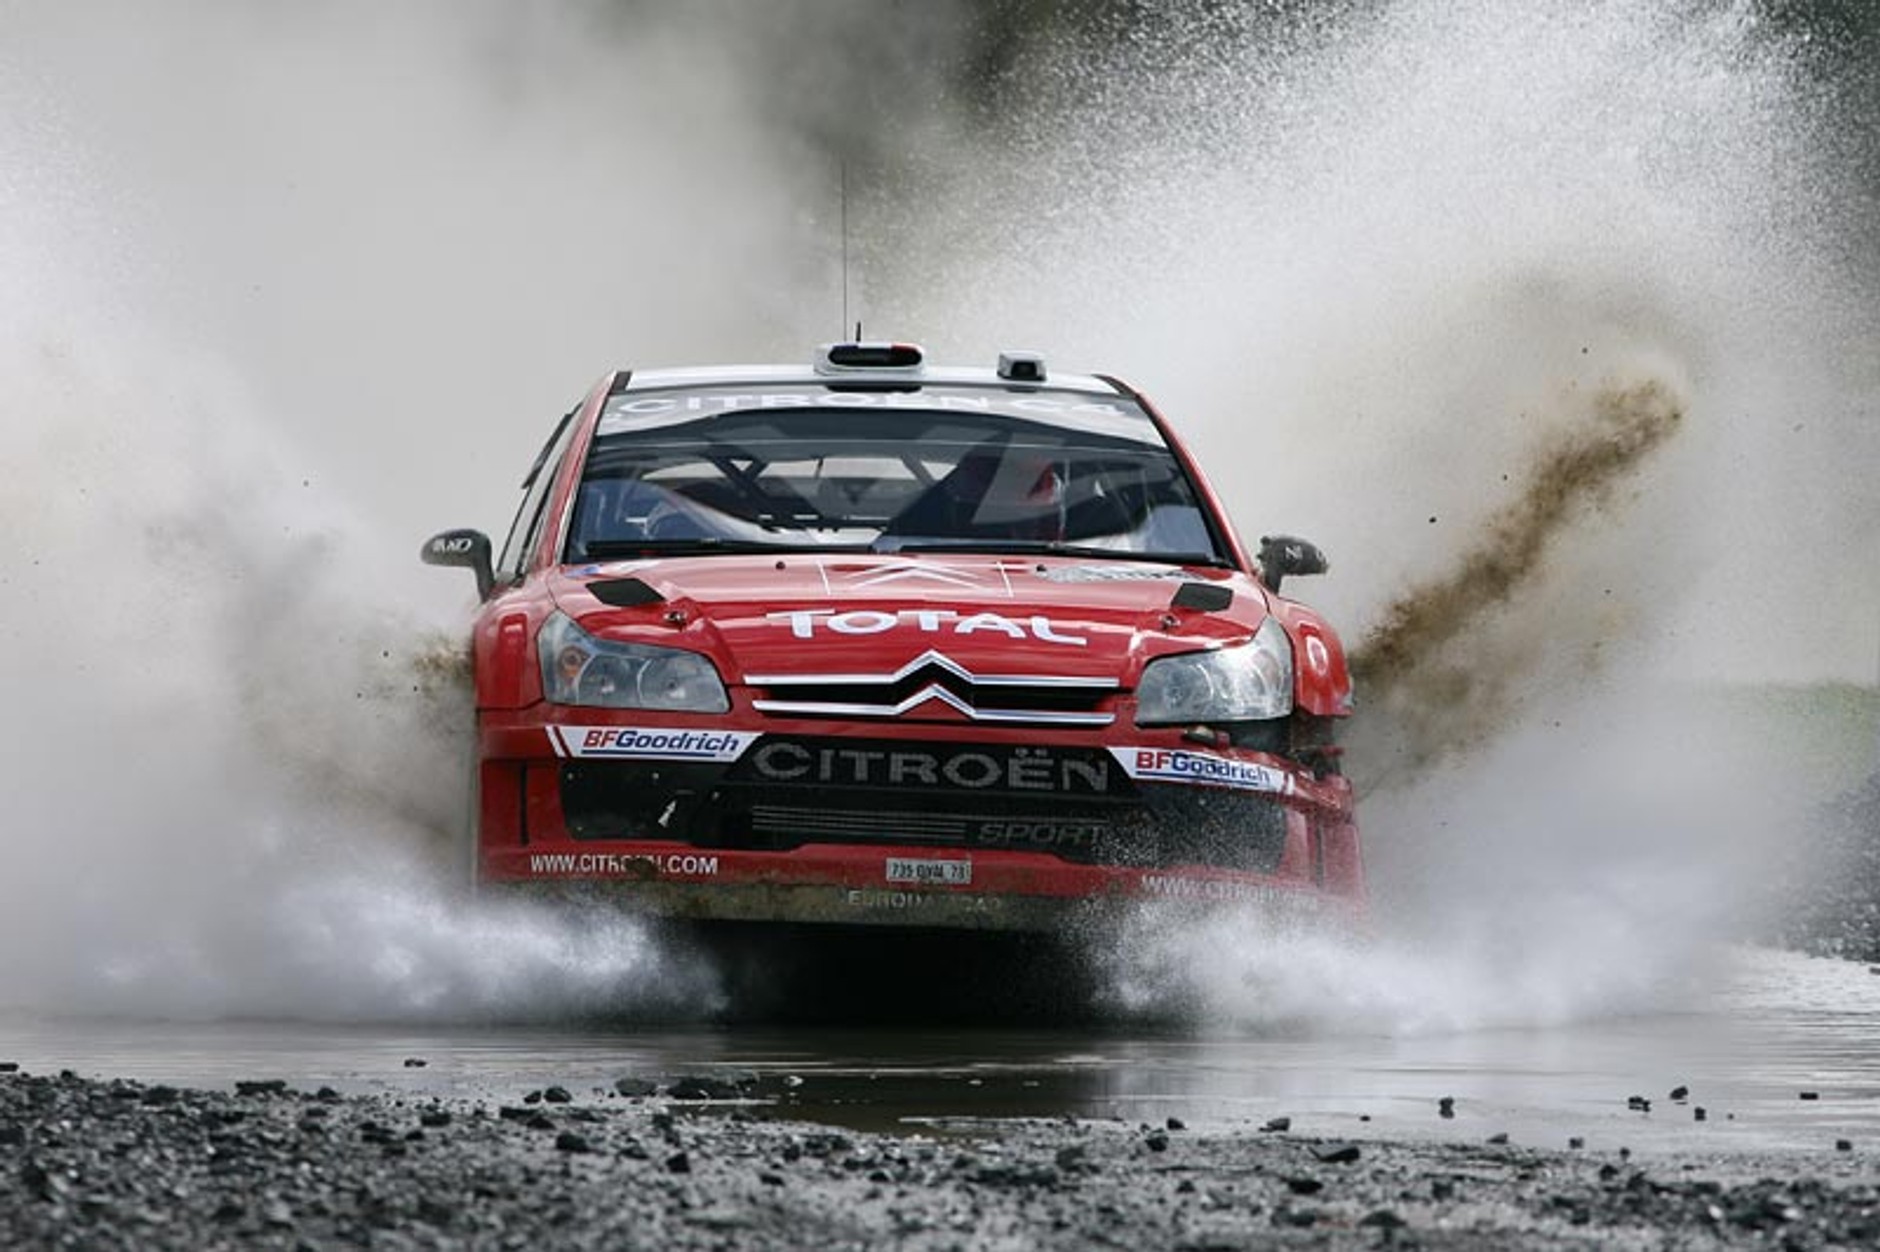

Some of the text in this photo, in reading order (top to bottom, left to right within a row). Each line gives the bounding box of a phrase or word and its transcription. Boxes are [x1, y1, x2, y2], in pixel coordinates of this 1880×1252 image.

[766, 608, 1088, 645] TOTAL
[583, 730, 739, 751] BFGoodrich
[752, 742, 1109, 791] CITROËN
[1136, 751, 1271, 783] BFGoodrich
[978, 822, 1103, 846] SPORT
[531, 854, 719, 875] WWW.CITRON.COM
